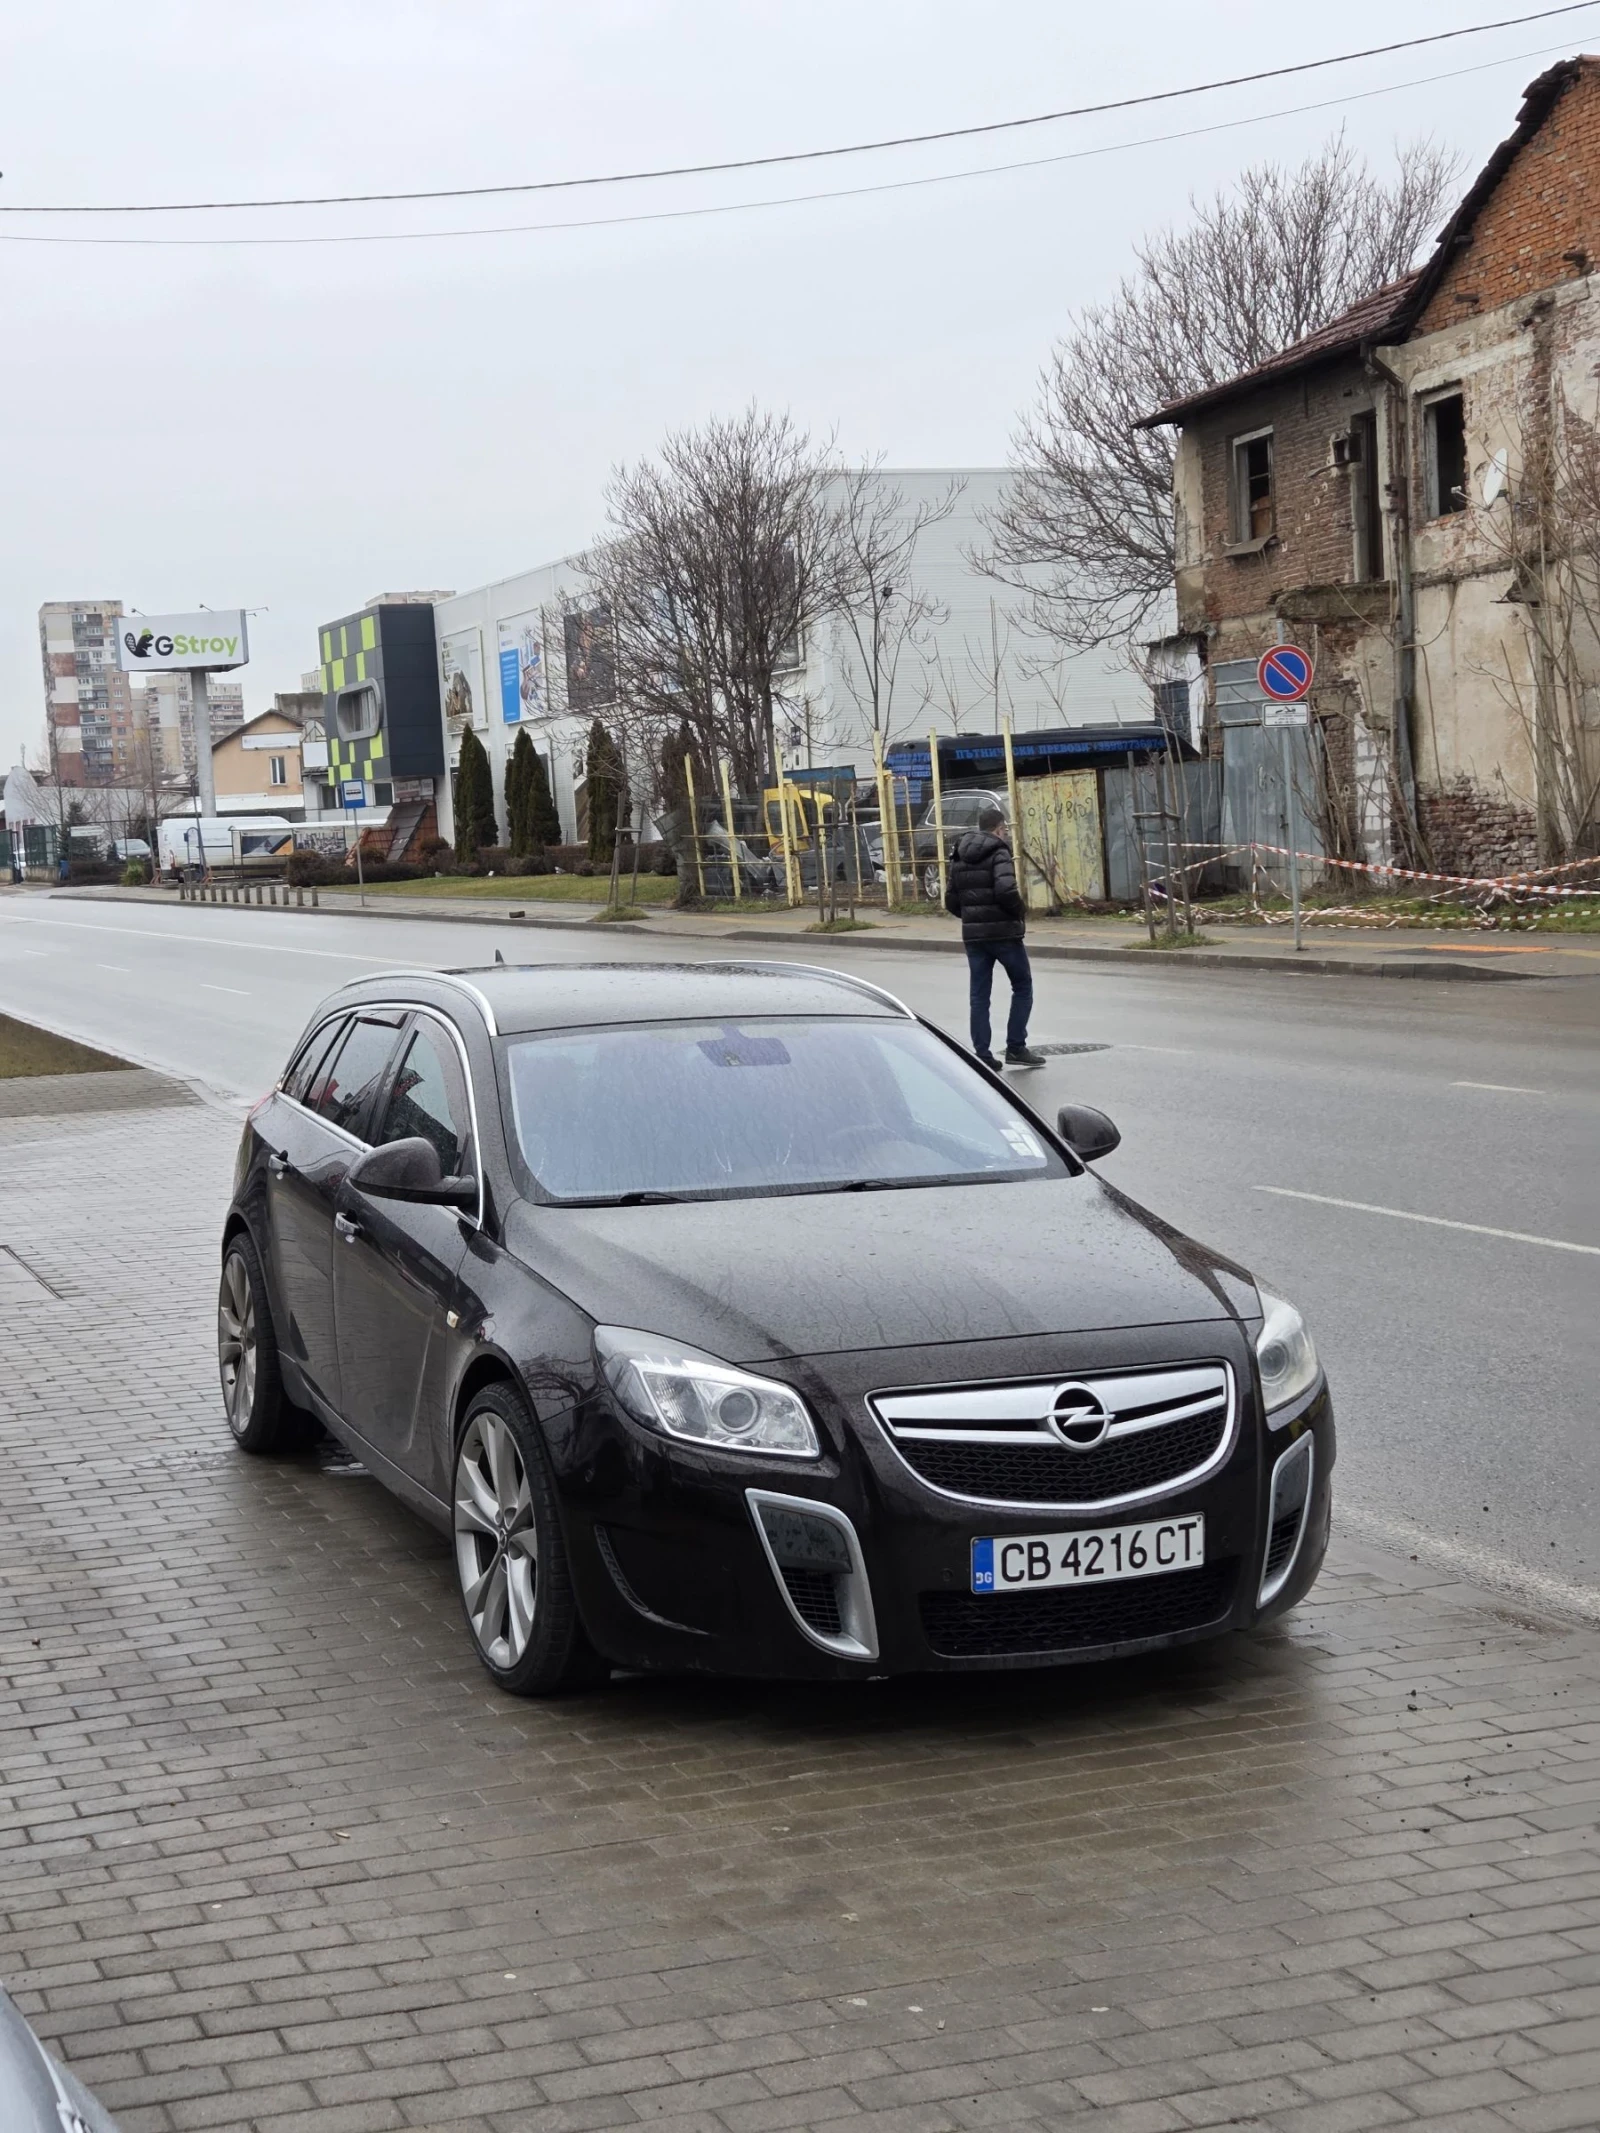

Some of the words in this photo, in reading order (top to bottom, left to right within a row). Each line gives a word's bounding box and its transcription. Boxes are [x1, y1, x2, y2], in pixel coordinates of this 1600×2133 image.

[155, 634, 238, 657] GStroy
[956, 745, 1034, 759] ПЪТНИЧСКИ
[1001, 1541, 1051, 1583] CB
[1061, 1530, 1148, 1577] 4216
[1156, 1522, 1198, 1565] CT
[976, 1572, 993, 1584] BG
